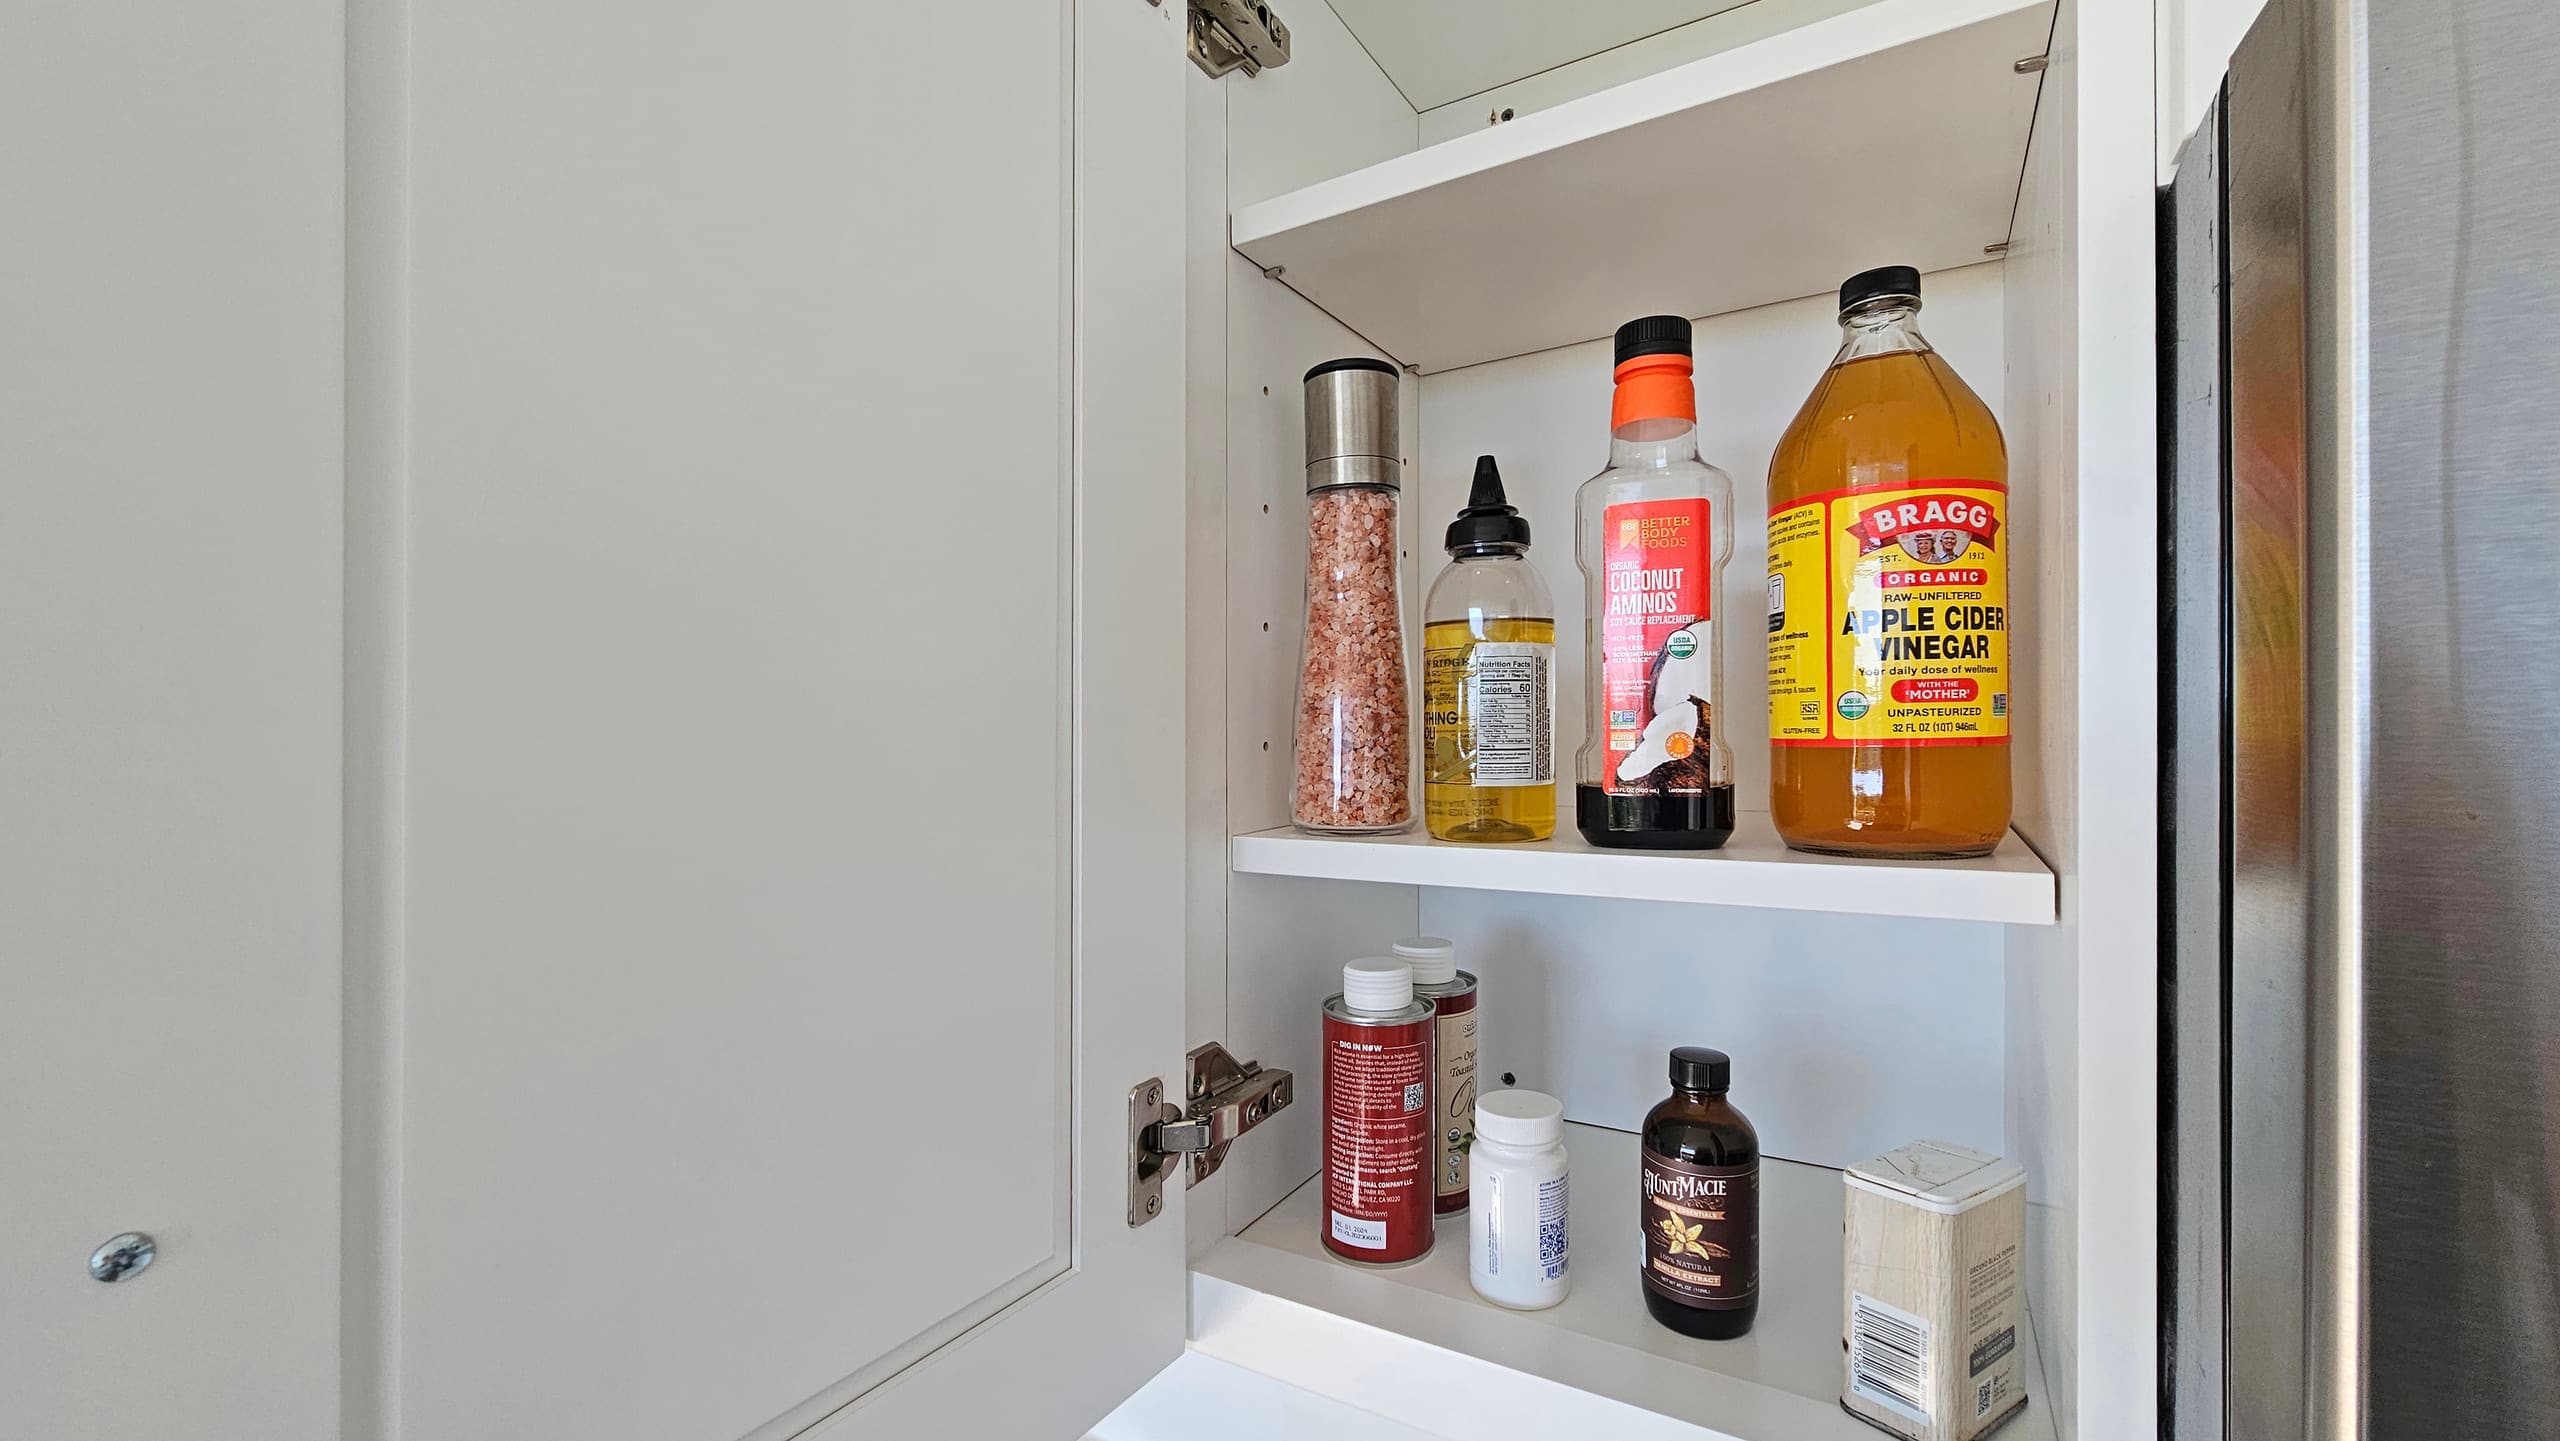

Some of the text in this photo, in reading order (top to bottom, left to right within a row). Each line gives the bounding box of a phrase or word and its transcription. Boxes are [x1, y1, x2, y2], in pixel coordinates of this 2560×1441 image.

[1641, 516, 1690, 528] BETTER
[1873, 501, 1987, 533] BRAGG
[1641, 527, 1678, 538] BODY
[1642, 537, 1687, 549] FOODS
[1879, 555, 1901, 563] EST.
[1969, 552, 1985, 560] 1912
[1610, 568, 1684, 592] COCONUT
[1888, 572, 1979, 585] ORGANIC
[1884, 592, 1982, 603] RAW-UNFILTERED
[1610, 592, 1677, 615] AMINOS
[1623, 616, 1647, 625] SAUCE
[1648, 615, 1696, 624] REPLACEMENT
[1842, 606, 2004, 635] APPLE CIDER
[1874, 635, 1989, 661] VINEGAR
[1858, 665, 1998, 678] Your daily dose of wellness
[1520, 683, 1530, 692] 60
[1888, 708, 1982, 717] UNPASTEURIZED
[1892, 723, 1904, 732] 32
[1906, 723, 1916, 732] FL
[1919, 723, 1930, 732] OZ
[1955, 722, 1978, 731] 946mL
[1340, 1041, 1351, 1049] DIG
[1353, 1043, 1360, 1051] IN
[1356, 1166, 1378, 1175] mazon,
[1404, 1178, 1414, 1187] LLC.
[1654, 1260, 1718, 1284] VANILLA EXTRACT
[1676, 1260, 1713, 1273] NATURAL
